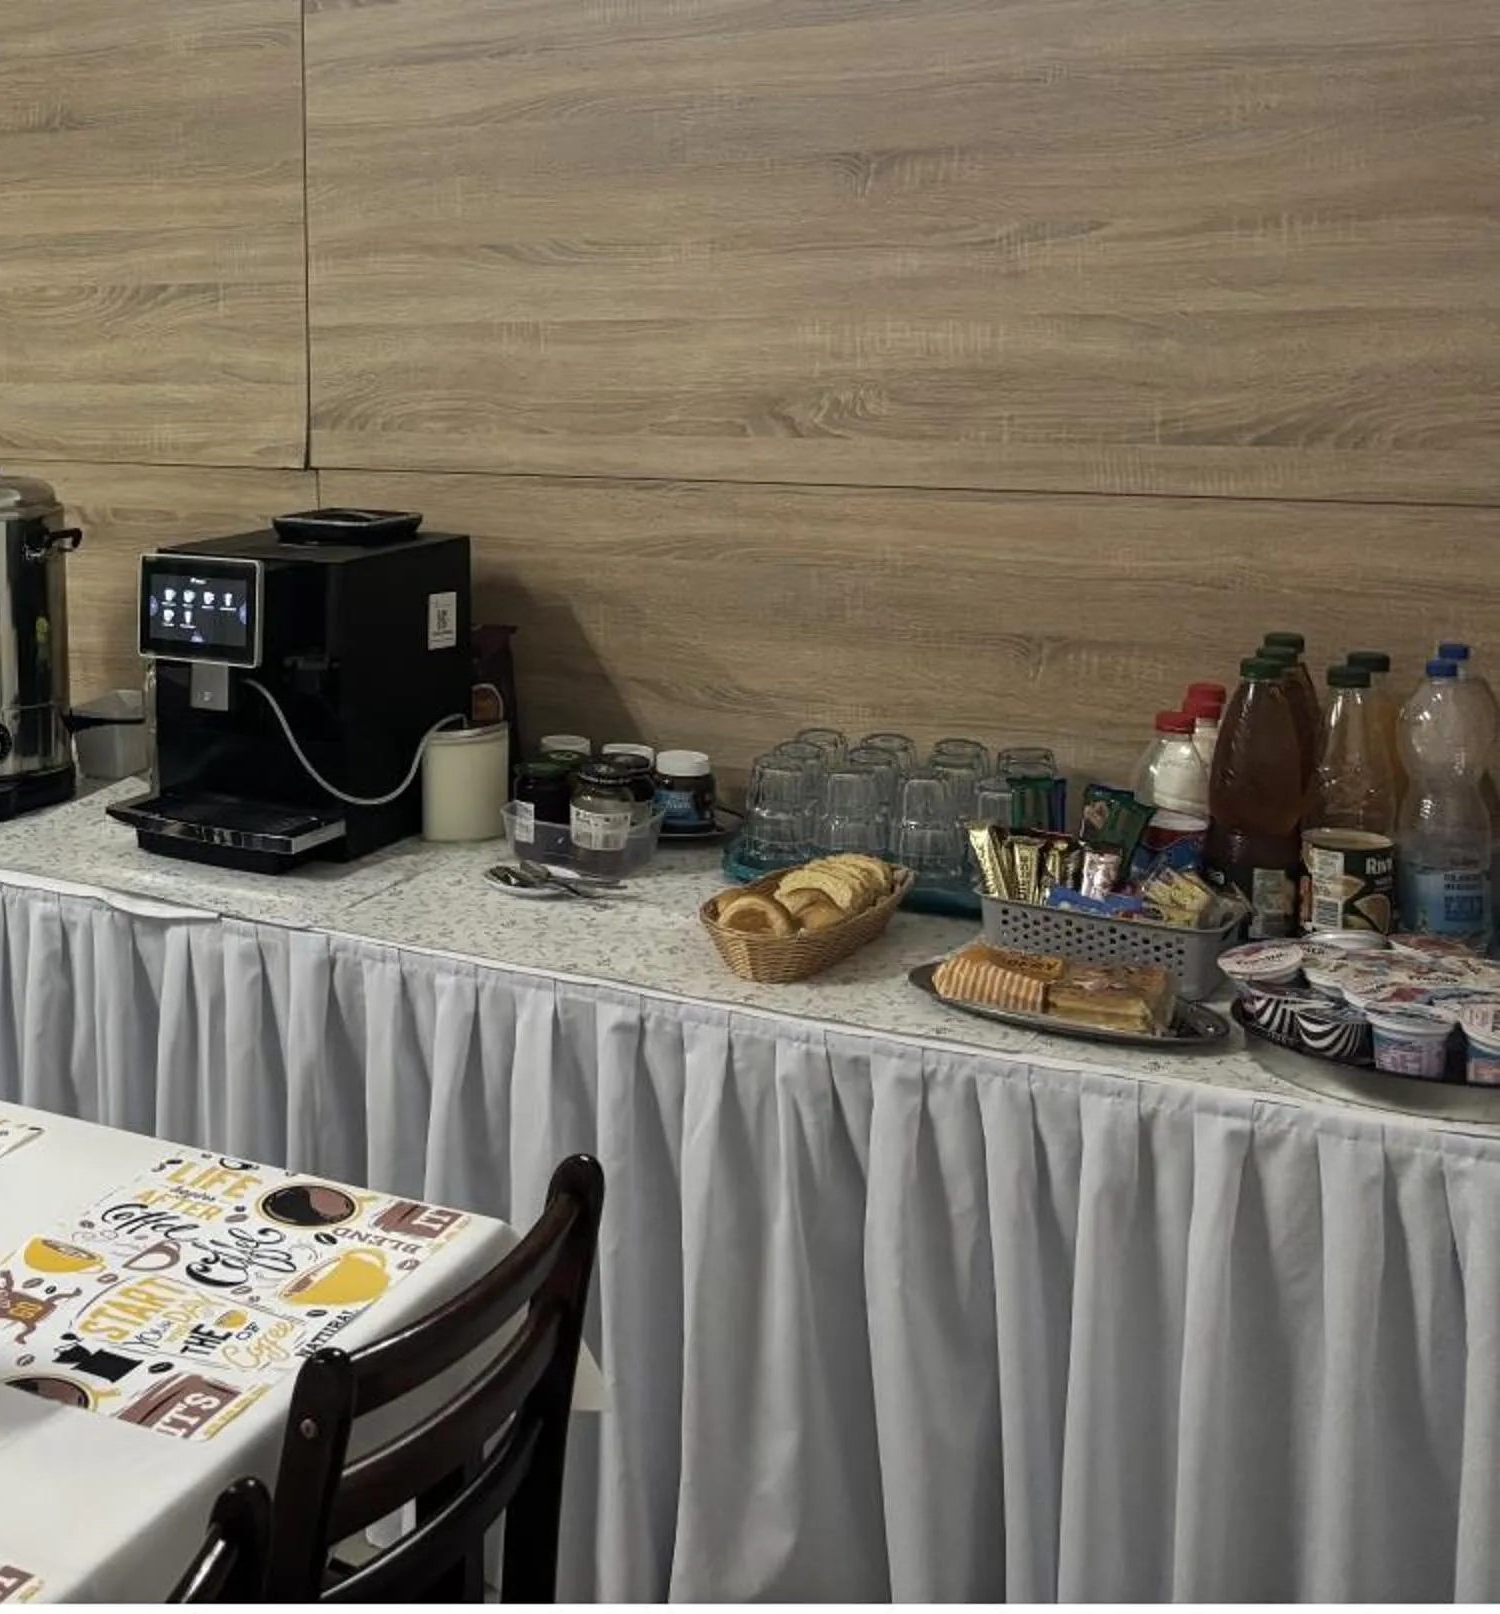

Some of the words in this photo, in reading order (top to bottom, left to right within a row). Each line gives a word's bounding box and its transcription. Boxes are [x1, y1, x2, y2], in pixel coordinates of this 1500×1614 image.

[166, 1162, 263, 1199] LIFE
[133, 1189, 223, 1220] AFTER
[331, 1227, 424, 1254] BLEND
[78, 1276, 187, 1341] START
[180, 1323, 233, 1355] THE
